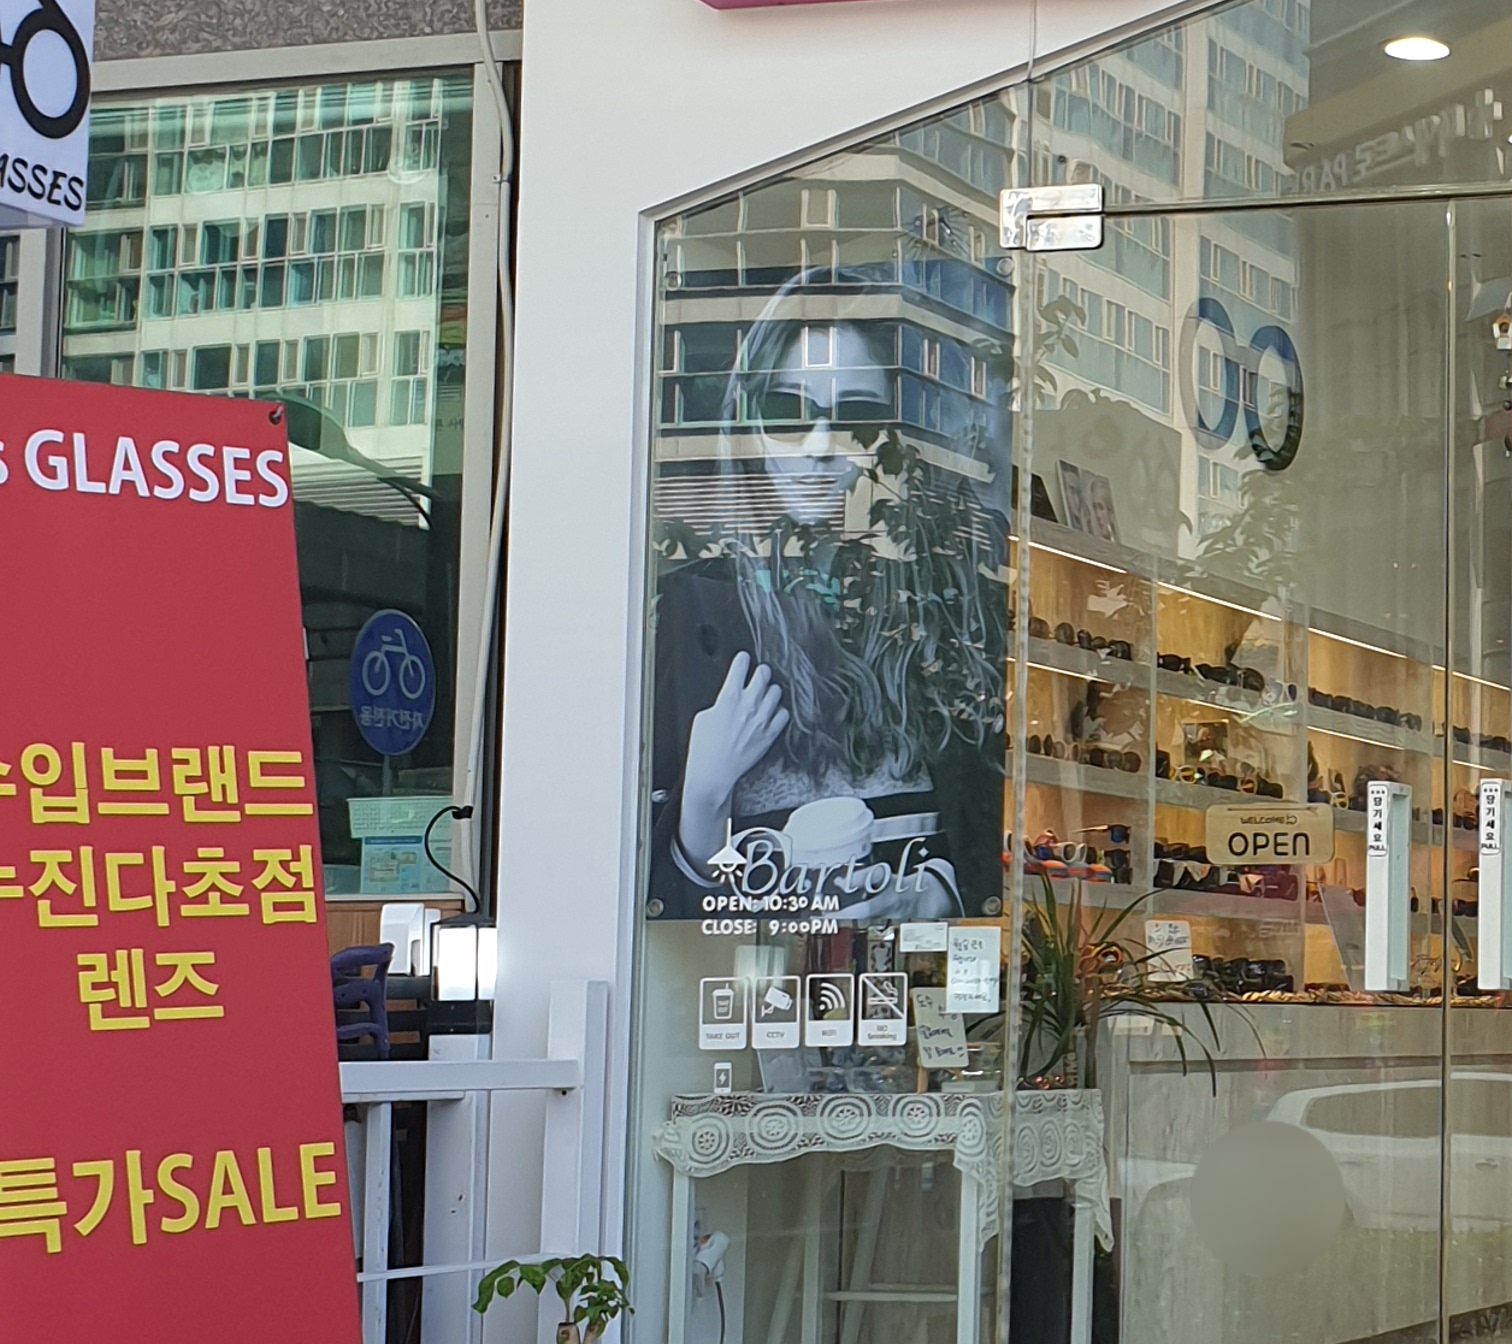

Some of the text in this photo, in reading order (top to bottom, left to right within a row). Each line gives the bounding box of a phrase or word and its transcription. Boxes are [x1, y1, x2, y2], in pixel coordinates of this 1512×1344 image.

[24, 428, 290, 508] GLASSES
[0, 741, 314, 824] 입브랜드
[742, 837, 930, 895] Bartoli
[1227, 831, 1311, 857] OPEN
[0, 845, 318, 928] 진다초점
[77, 948, 225, 1031] 렌즈
